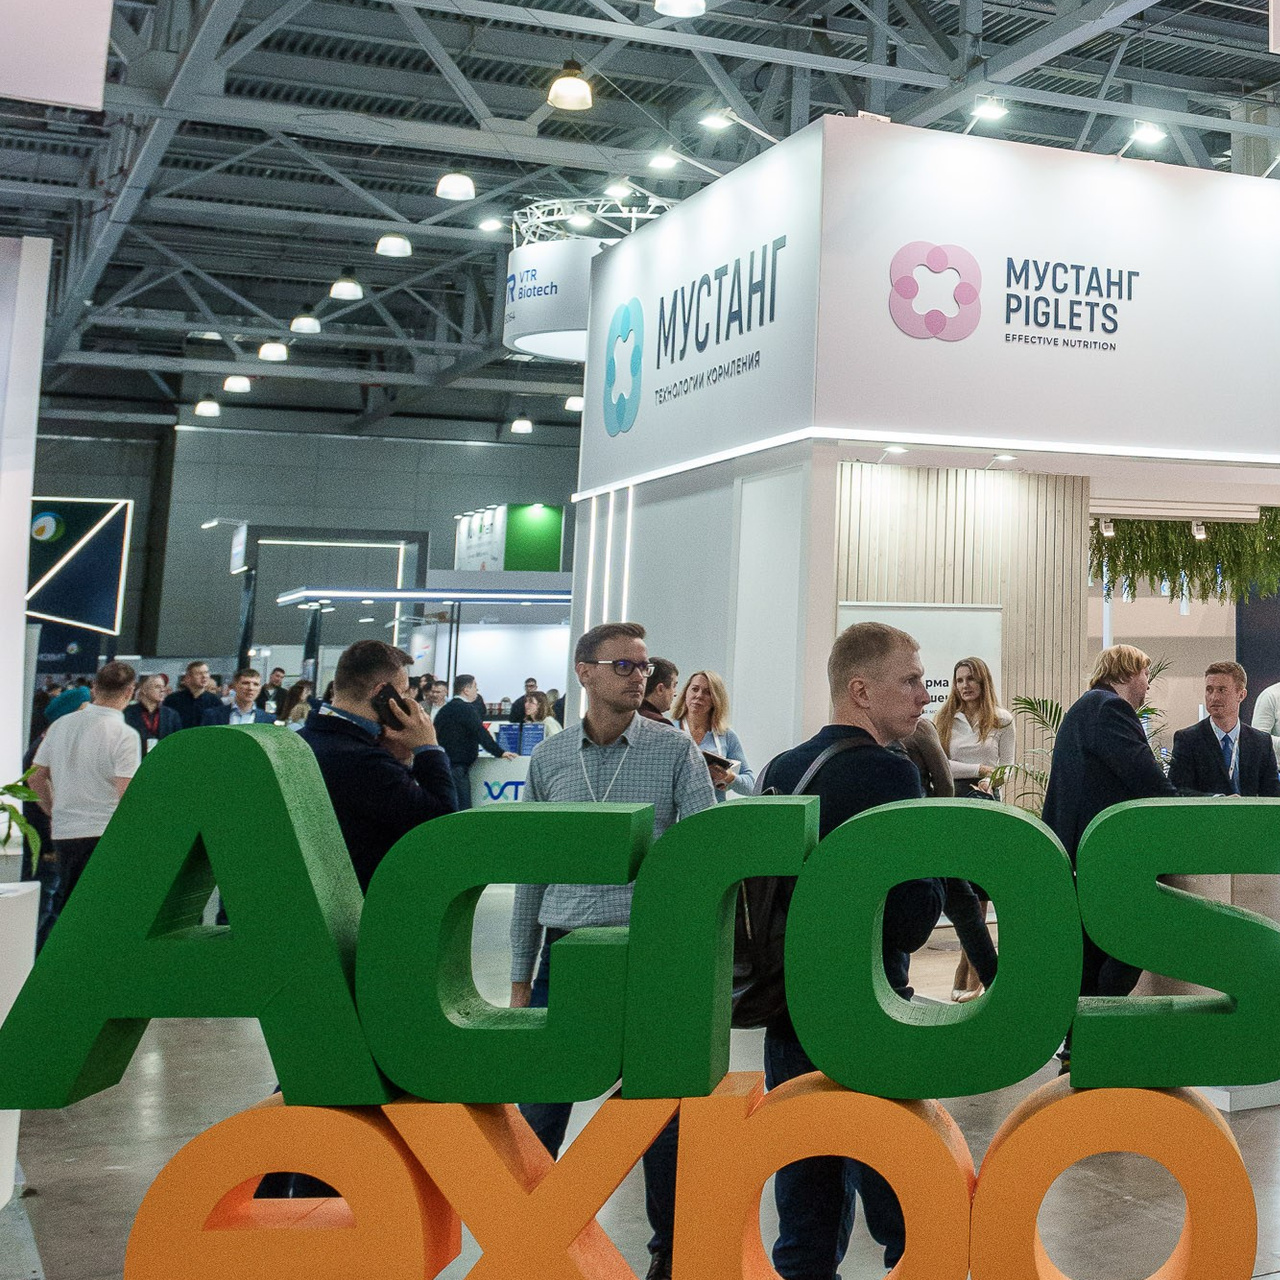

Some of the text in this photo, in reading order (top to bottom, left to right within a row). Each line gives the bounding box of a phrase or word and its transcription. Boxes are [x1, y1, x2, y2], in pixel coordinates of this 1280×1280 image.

[518, 281, 558, 300] Biotech
[519, 269, 537, 283] VTR
[1006, 257, 1140, 301] МУСТАНГ
[656, 234, 787, 370] МУСТАНГ
[1005, 293, 1118, 334] PIGLETS
[1005, 333, 1116, 351] EFFECTIVE NUTRITION
[654, 350, 760, 406] ТЕХНОЛОГИИ КОРМЛЕНИЯ
